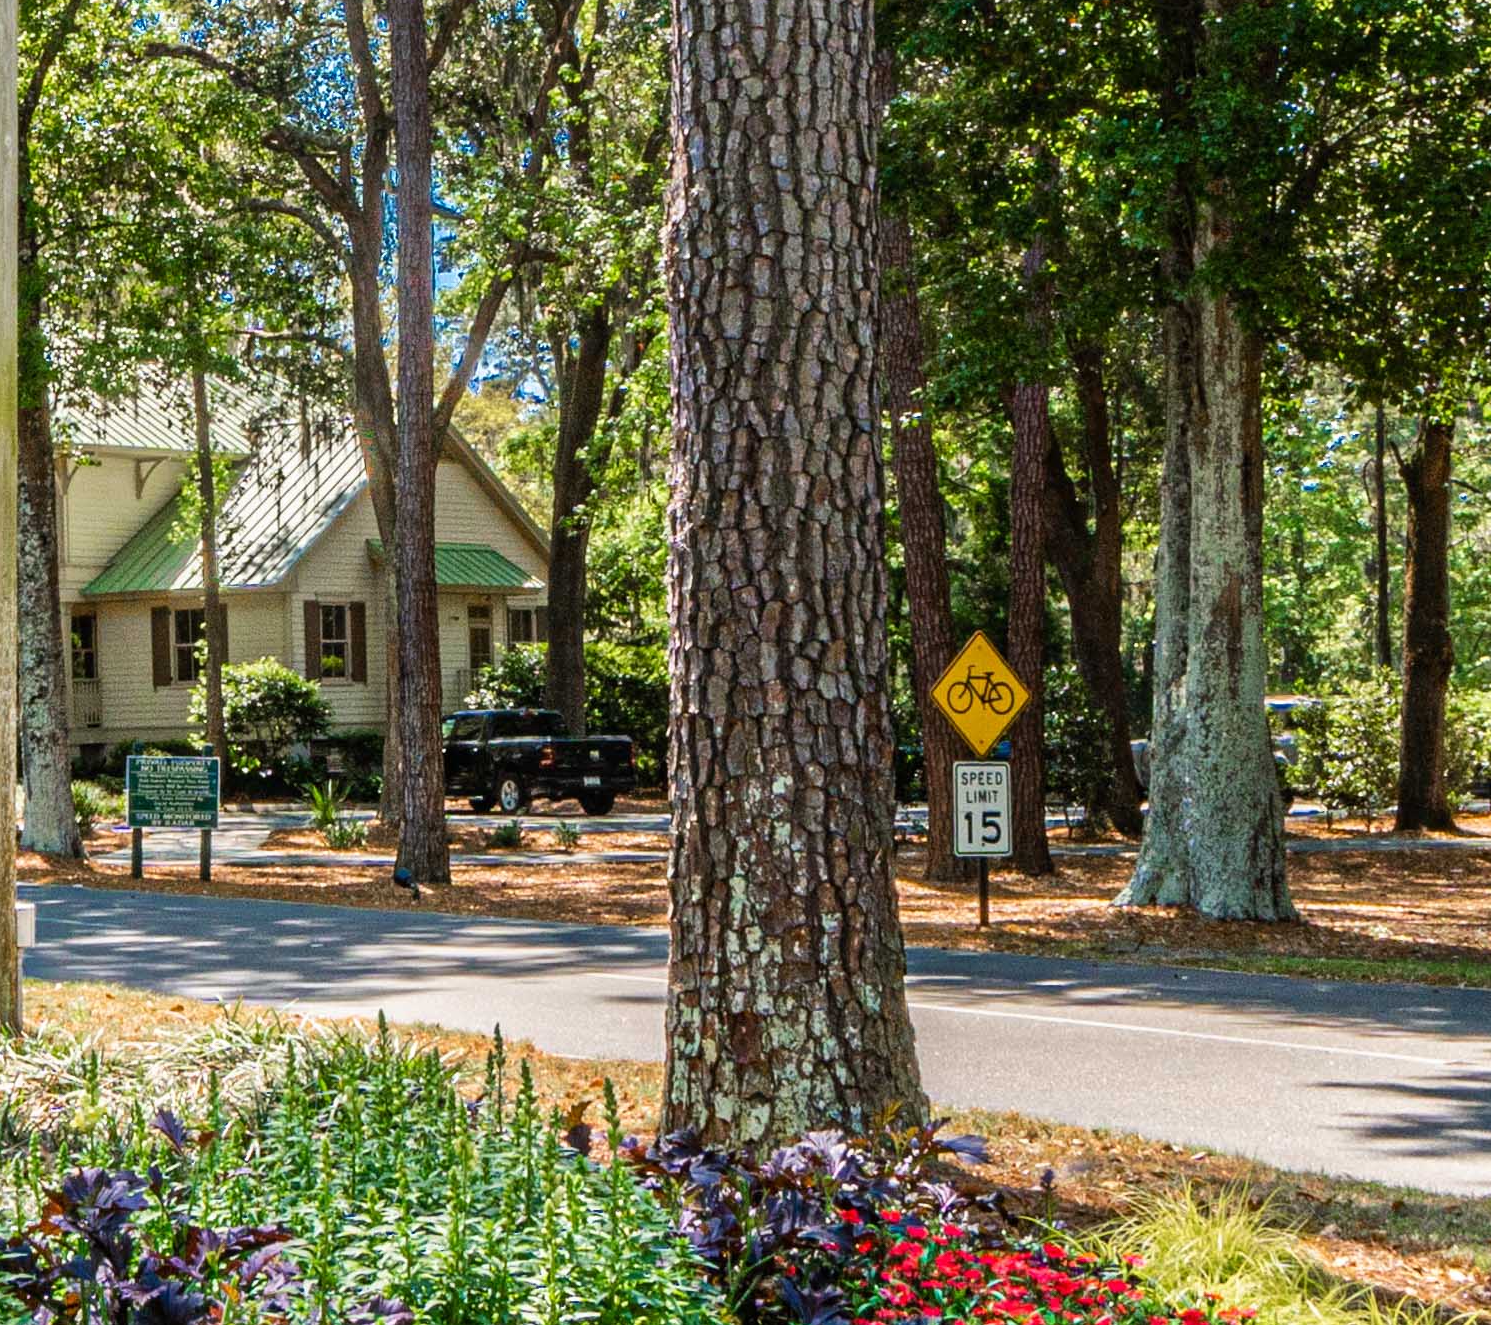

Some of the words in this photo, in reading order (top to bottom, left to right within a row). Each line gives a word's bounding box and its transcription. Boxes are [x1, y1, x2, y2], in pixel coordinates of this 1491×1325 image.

[157, 765, 208, 773] TRESPASSING
[961, 771, 1003, 785] SPEED
[966, 790, 998, 803] LIMIT
[964, 811, 1002, 844] 15
